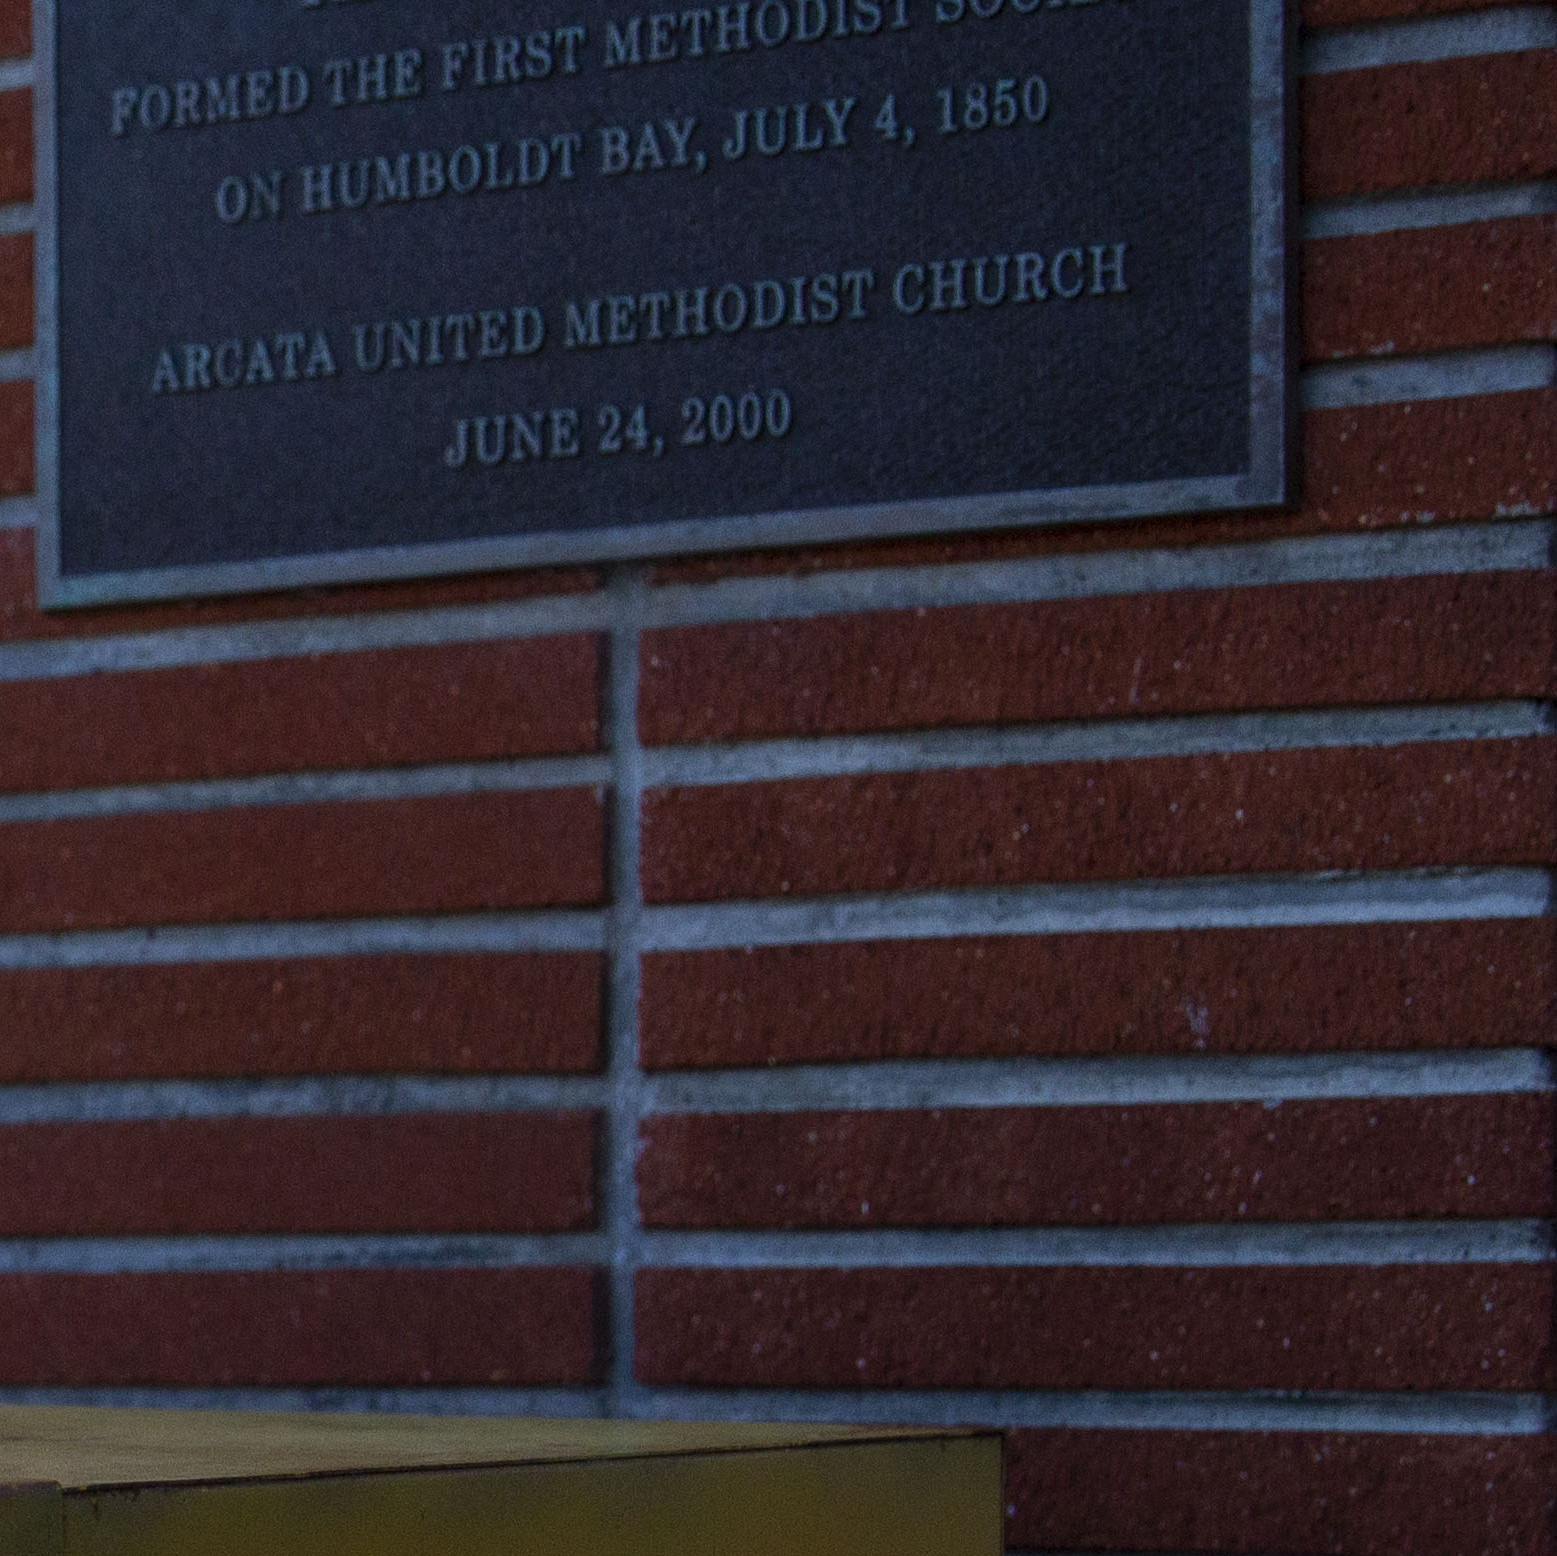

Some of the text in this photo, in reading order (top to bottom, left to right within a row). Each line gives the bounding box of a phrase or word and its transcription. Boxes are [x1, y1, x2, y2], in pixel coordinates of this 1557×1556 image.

[109, 0, 911, 138] FORMED THE FIRST METHODIST
[214, 76, 1050, 224] ON HUMBOLDT BAY, JULY 4, 1850
[152, 242, 1132, 398] ARCATA UNITED METHODIST CHURCH
[443, 389, 793, 470] JUNE 24, 2000
